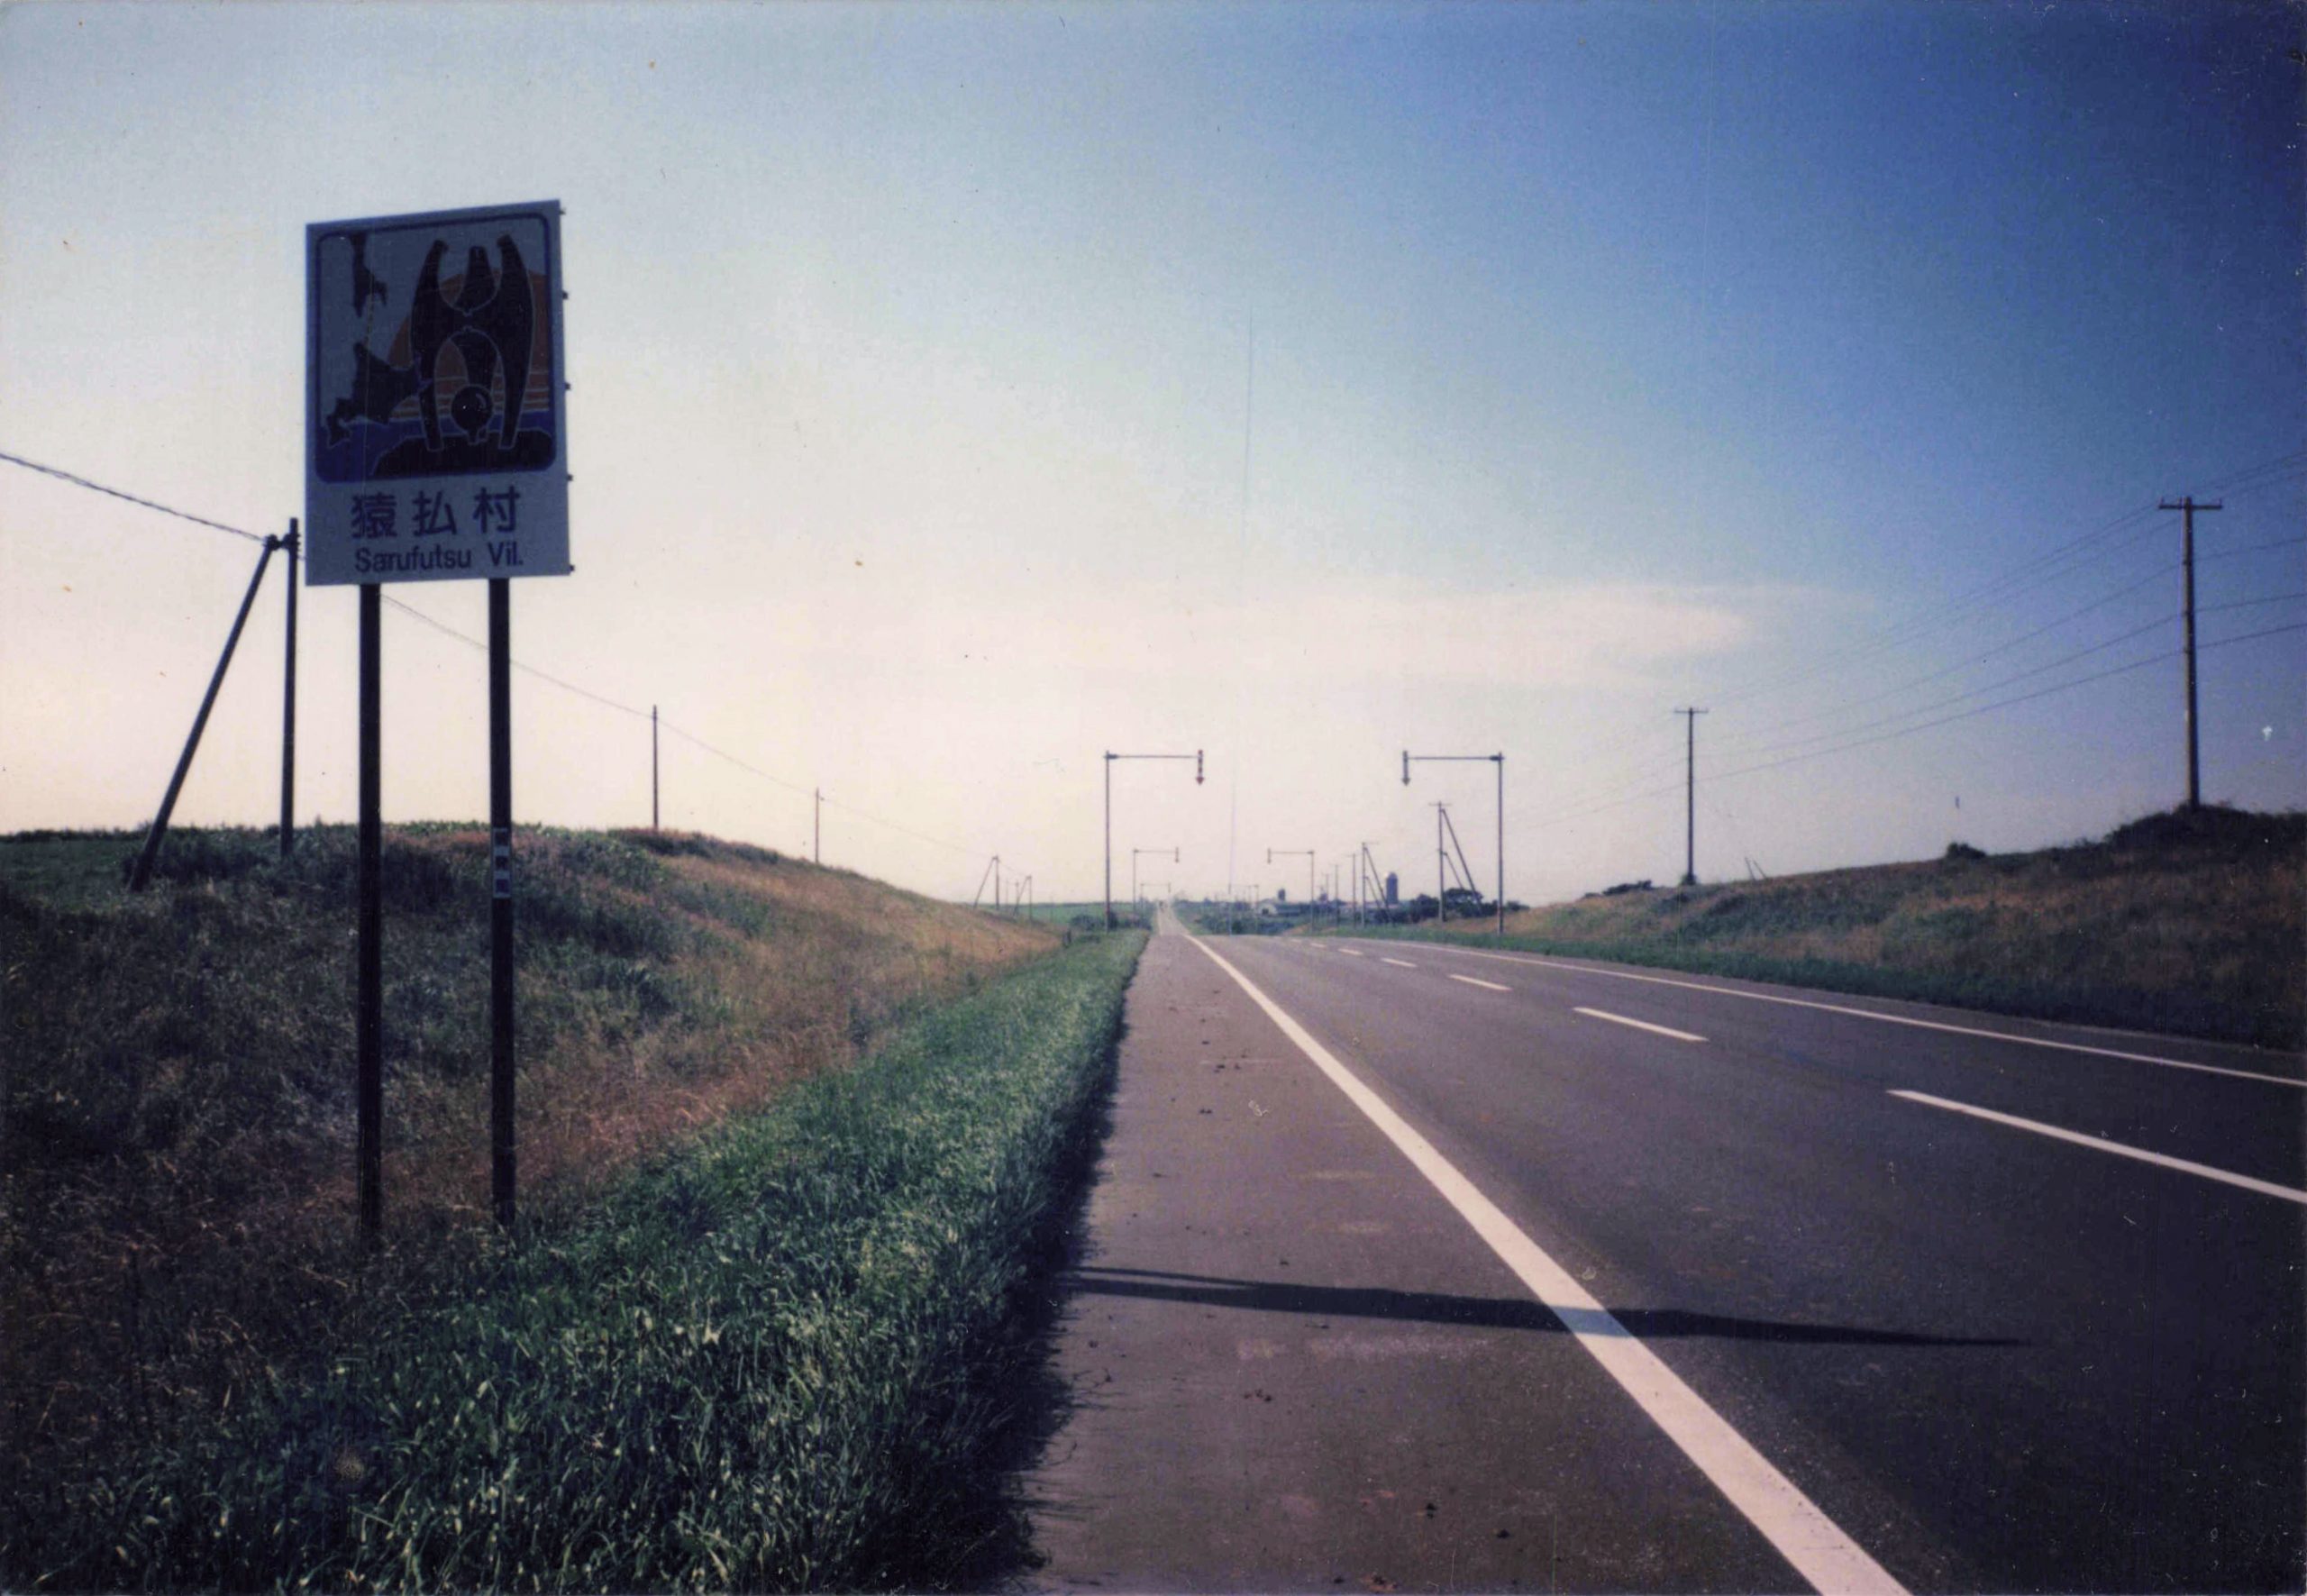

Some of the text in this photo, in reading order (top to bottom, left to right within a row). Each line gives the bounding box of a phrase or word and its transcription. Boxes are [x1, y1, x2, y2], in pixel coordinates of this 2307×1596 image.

[351, 486, 521, 539] 猿払村
[354, 541, 524, 573] Sarufutsu Vil.
